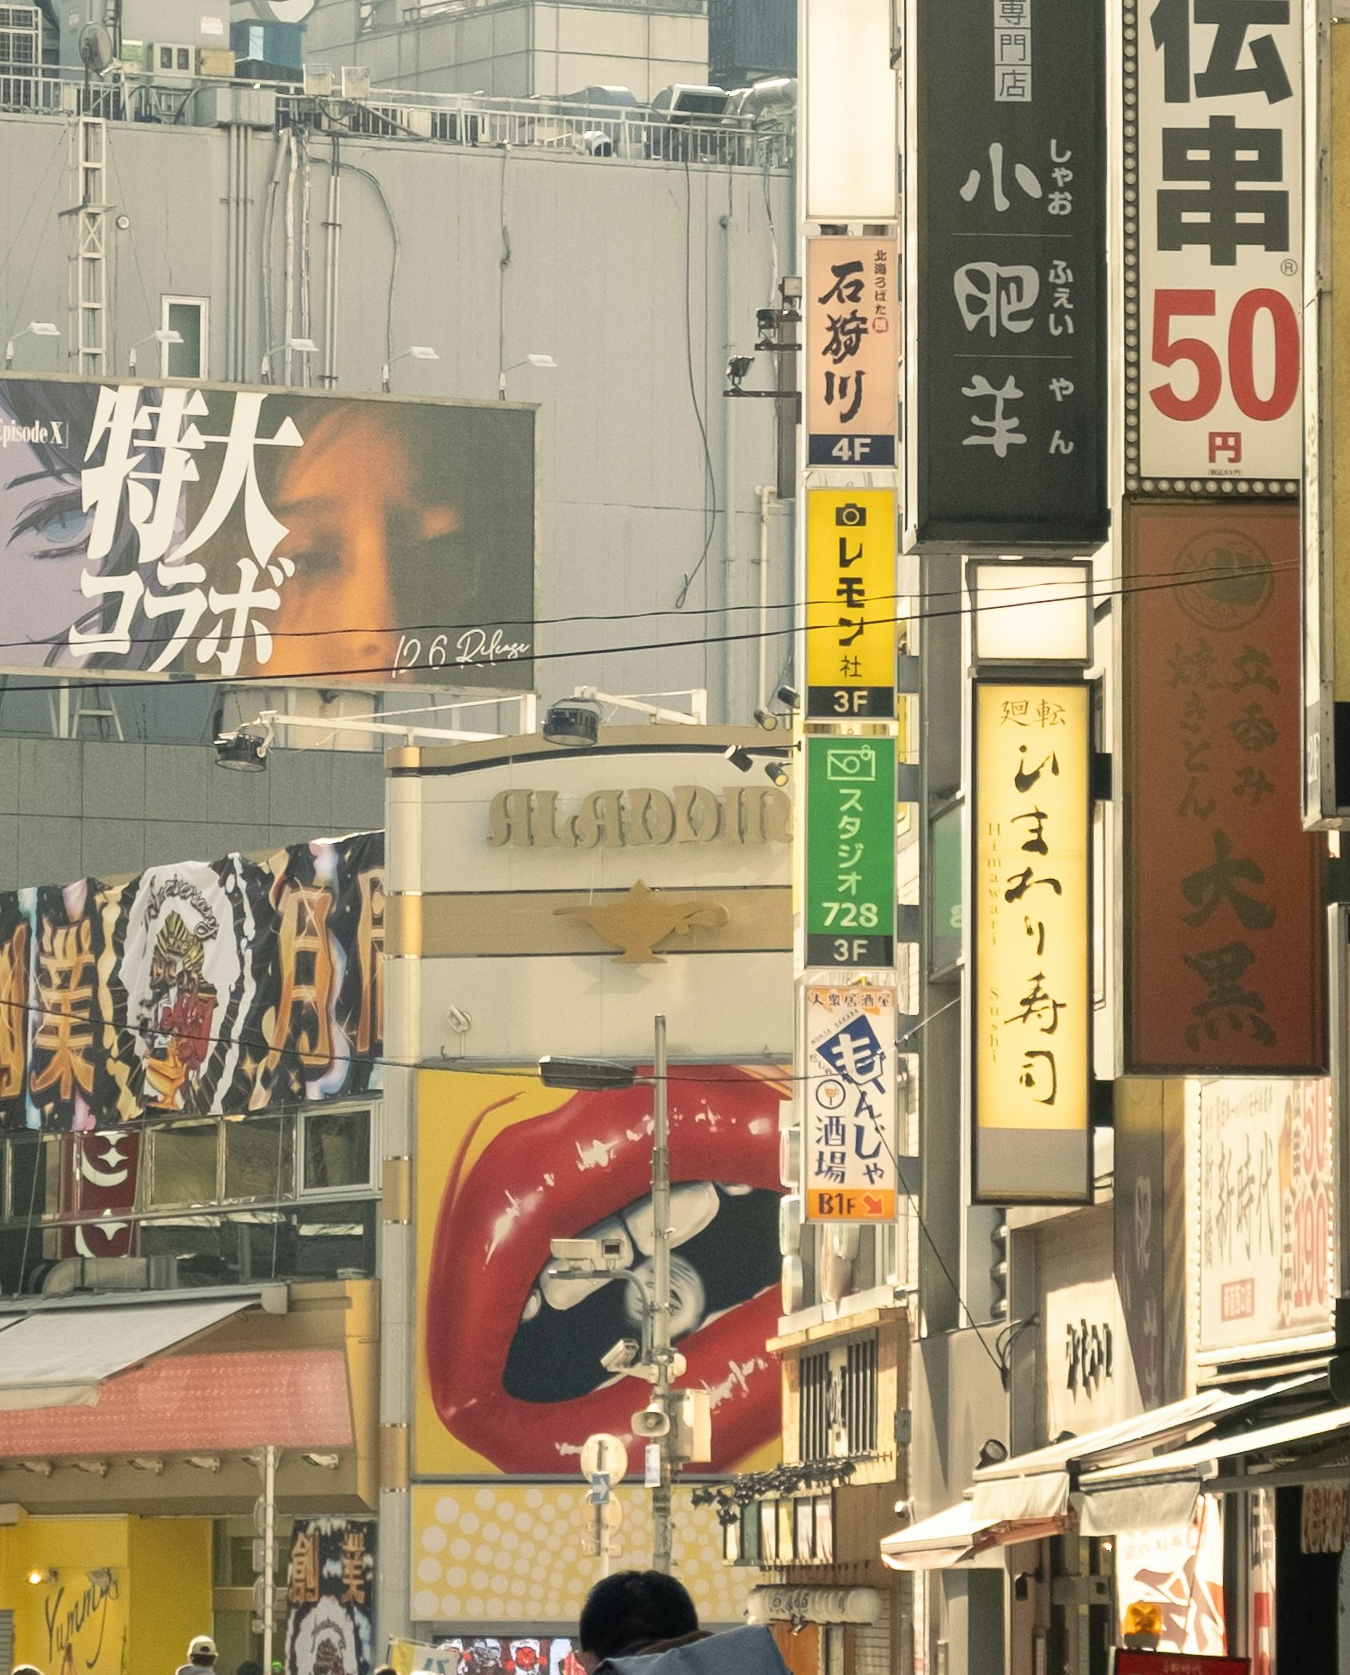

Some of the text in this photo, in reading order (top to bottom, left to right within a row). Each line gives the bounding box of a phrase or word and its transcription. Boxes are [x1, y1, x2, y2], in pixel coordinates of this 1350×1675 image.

[1047, 140, 1074, 218] しゃお
[817, 259, 870, 424] 石狩川
[954, 142, 1042, 458] 小肥羊
[1149, 287, 1300, 423] 50
[831, 437, 872, 462] 4F
[1048, 377, 1075, 455] やん
[1207, 430, 1244, 466] 円
[82, 385, 304, 571] 特大
[68, 556, 296, 677] コラボ
[837, 535, 866, 680] レモン社
[834, 690, 868, 715] 3F
[486, 784, 793, 852] ALADDIN
[838, 788, 863, 896] スタジオ
[822, 903, 879, 928] 728
[834, 938, 868, 964] 3F
[987, 822, 1002, 1064] Himawari Sushi
[1003, 744, 1068, 1106] ひまわり寿司
[1179, 827, 1278, 1052] 大黒
[815, 1115, 847, 1185] 酒場
[818, 1192, 857, 1217] B1F
